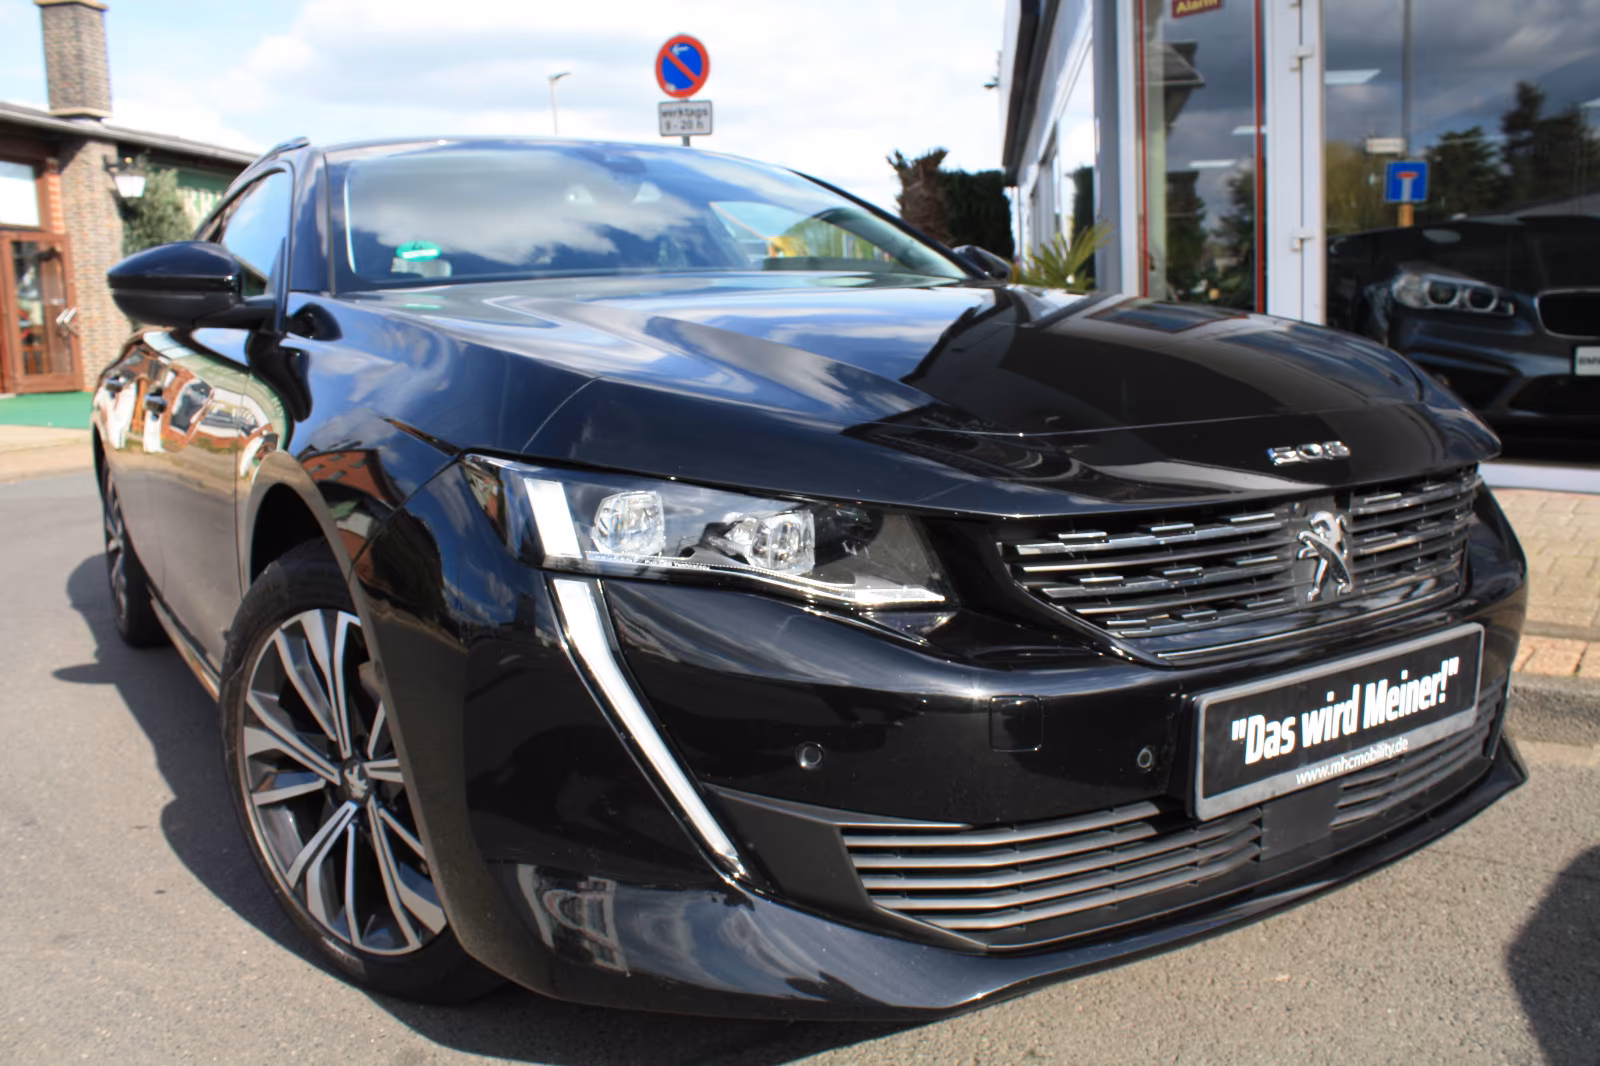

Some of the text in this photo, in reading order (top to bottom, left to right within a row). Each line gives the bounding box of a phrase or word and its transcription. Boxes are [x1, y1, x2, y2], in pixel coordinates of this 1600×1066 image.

[1231, 656, 1459, 765] "Das wird Meiner!"
[1296, 737, 1409, 785] www.mhcmobility.de
